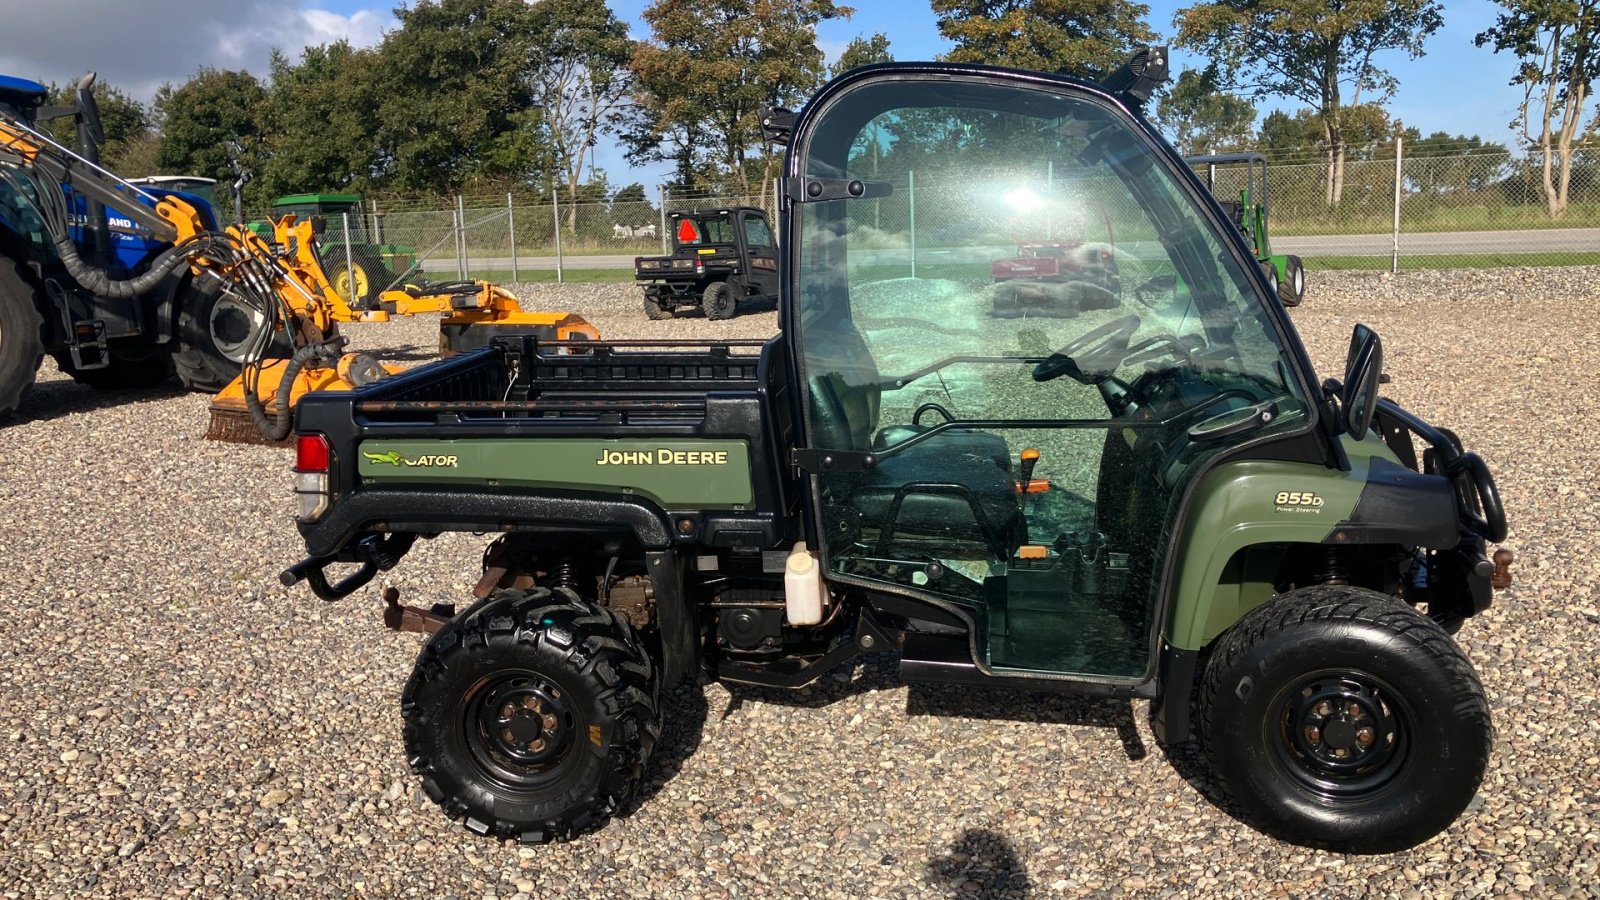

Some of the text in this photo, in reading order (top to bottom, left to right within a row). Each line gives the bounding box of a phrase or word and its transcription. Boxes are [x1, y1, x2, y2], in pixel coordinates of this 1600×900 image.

[597, 448, 728, 465] JOHN DEERE
[1275, 491, 1324, 505] 855D
[1296, 506, 1320, 514] Steering
